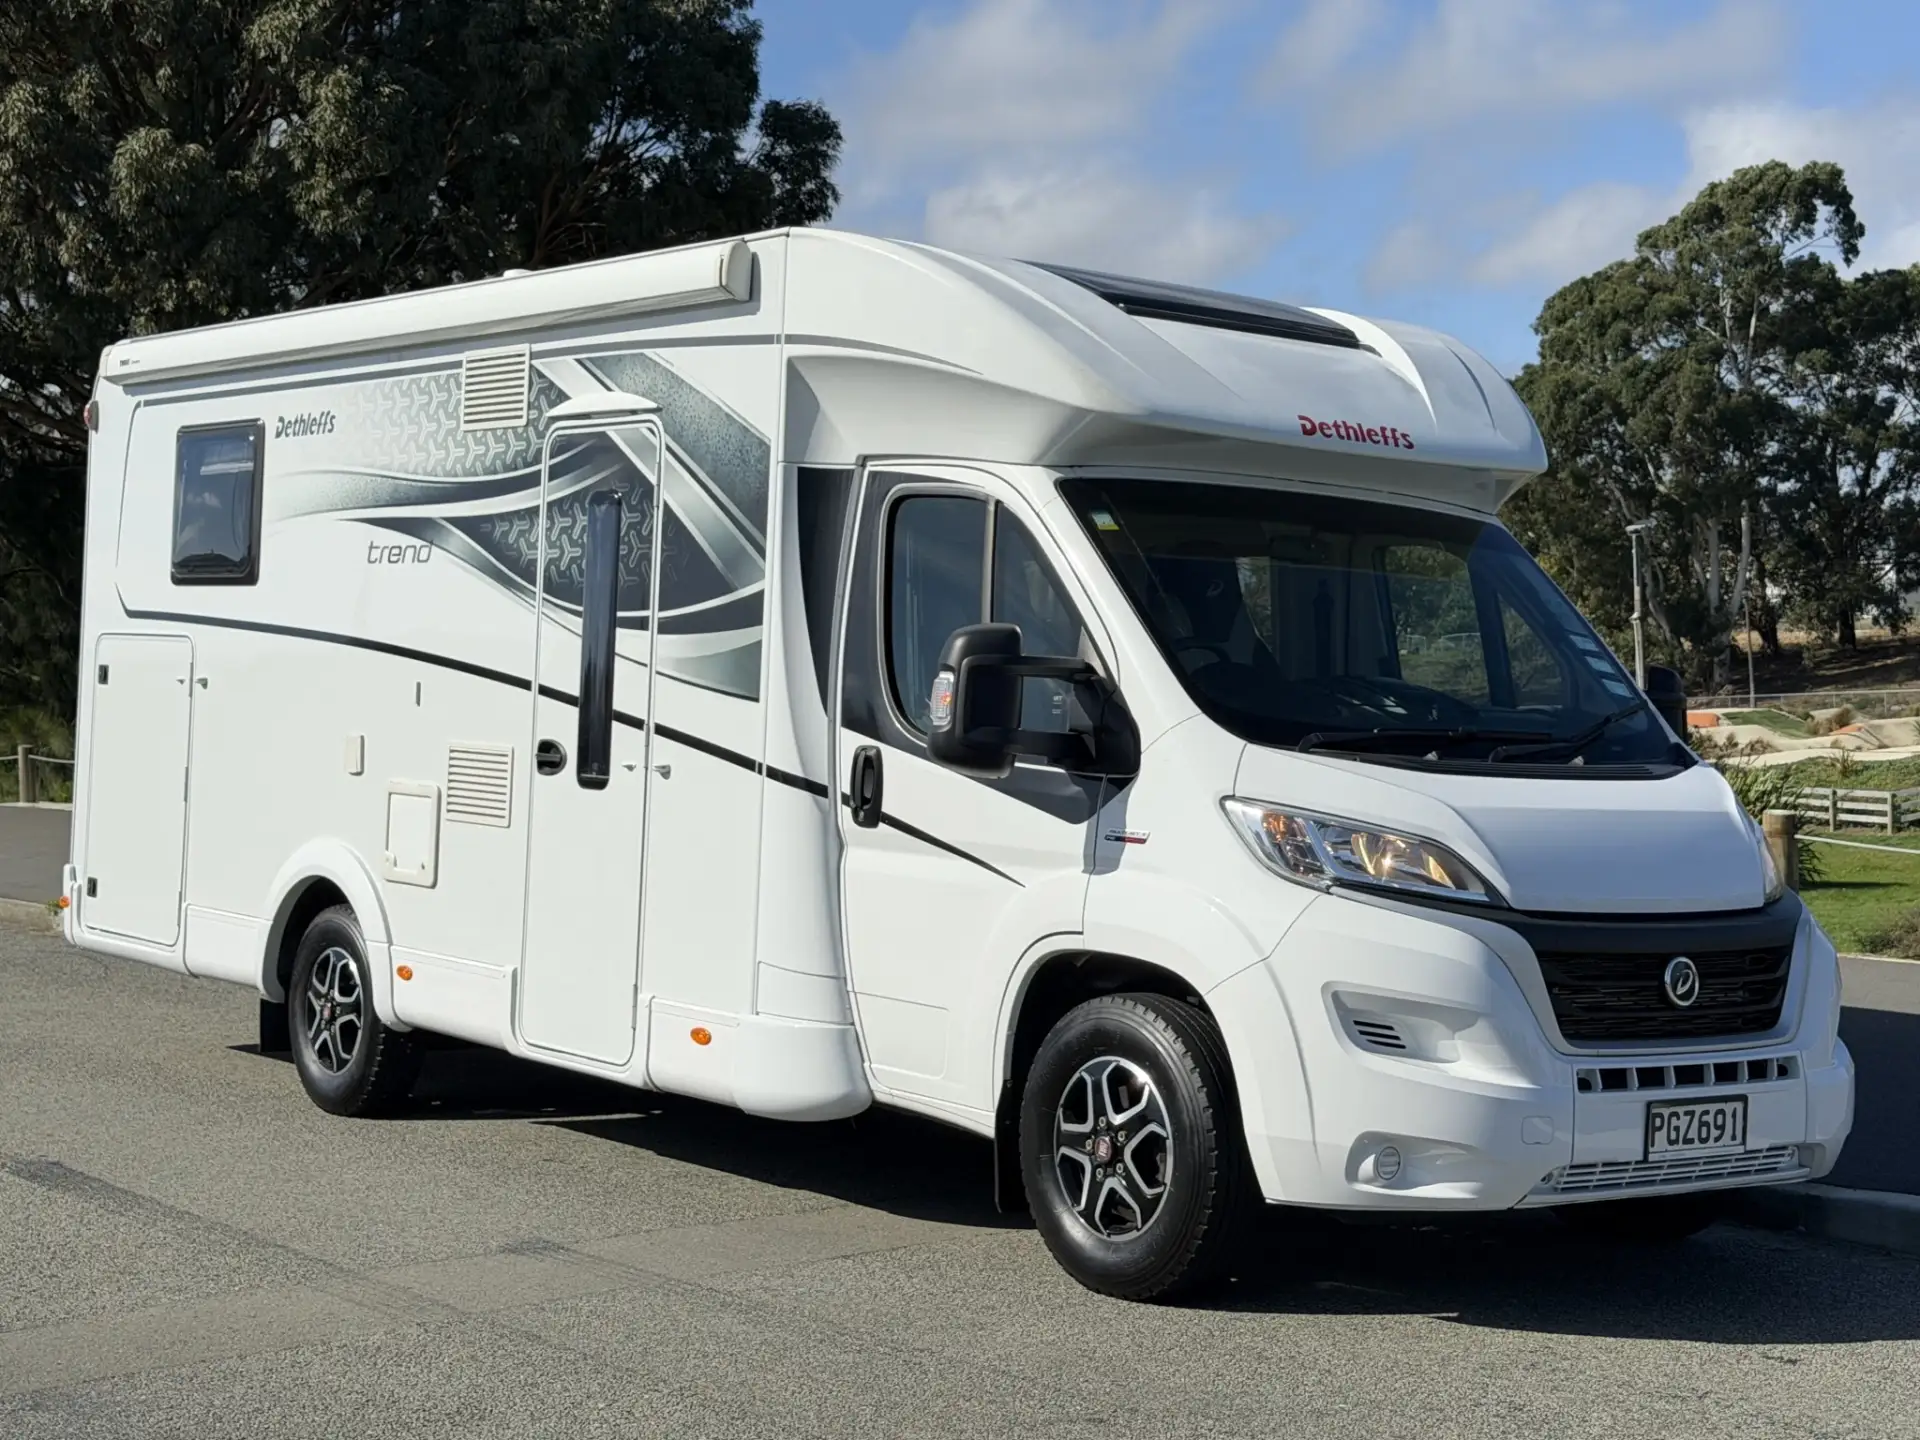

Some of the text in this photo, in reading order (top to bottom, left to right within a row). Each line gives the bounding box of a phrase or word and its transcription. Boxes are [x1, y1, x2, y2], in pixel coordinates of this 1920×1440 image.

[275, 410, 336, 439] Dethleffs
[1297, 414, 1414, 450] Dethleffs
[367, 540, 433, 564] trend
[1650, 1107, 1738, 1148] PGZ691
